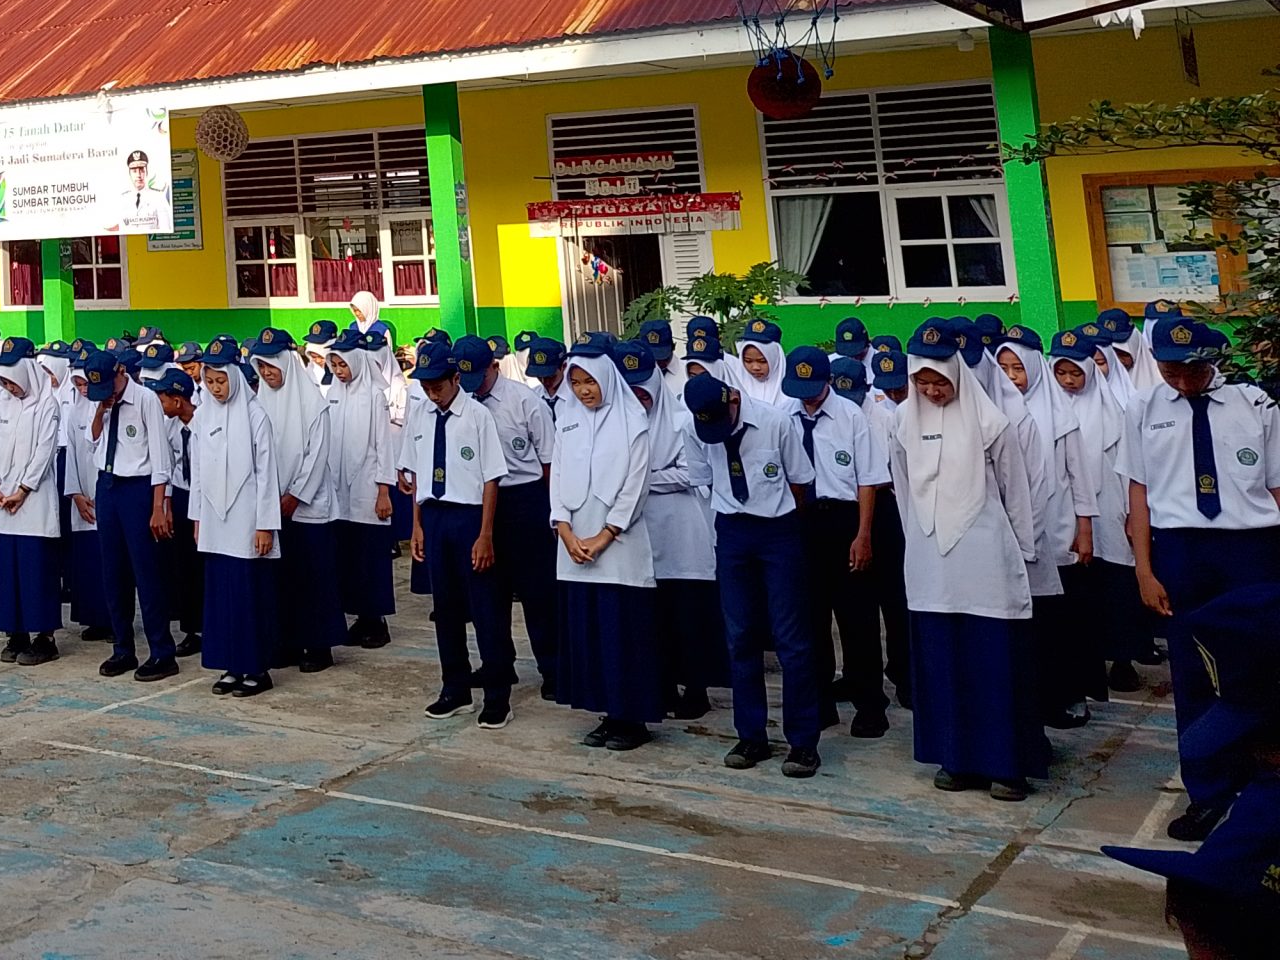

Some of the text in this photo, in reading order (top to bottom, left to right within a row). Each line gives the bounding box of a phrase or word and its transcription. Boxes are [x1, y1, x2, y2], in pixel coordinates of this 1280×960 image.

[3, 127, 15, 139] 15
[19, 123, 50, 137] Tanah
[54, 122, 86, 134] Datar
[7, 153, 30, 166] Jadi
[32, 150, 84, 164] Sumatera
[87, 146, 118, 159] Barat
[555, 154, 673, 172] DIRGAHAYU
[12, 182, 89, 197] SUMBAR TUMBUH
[12, 194, 96, 209] SUMBAR TANGGUH
